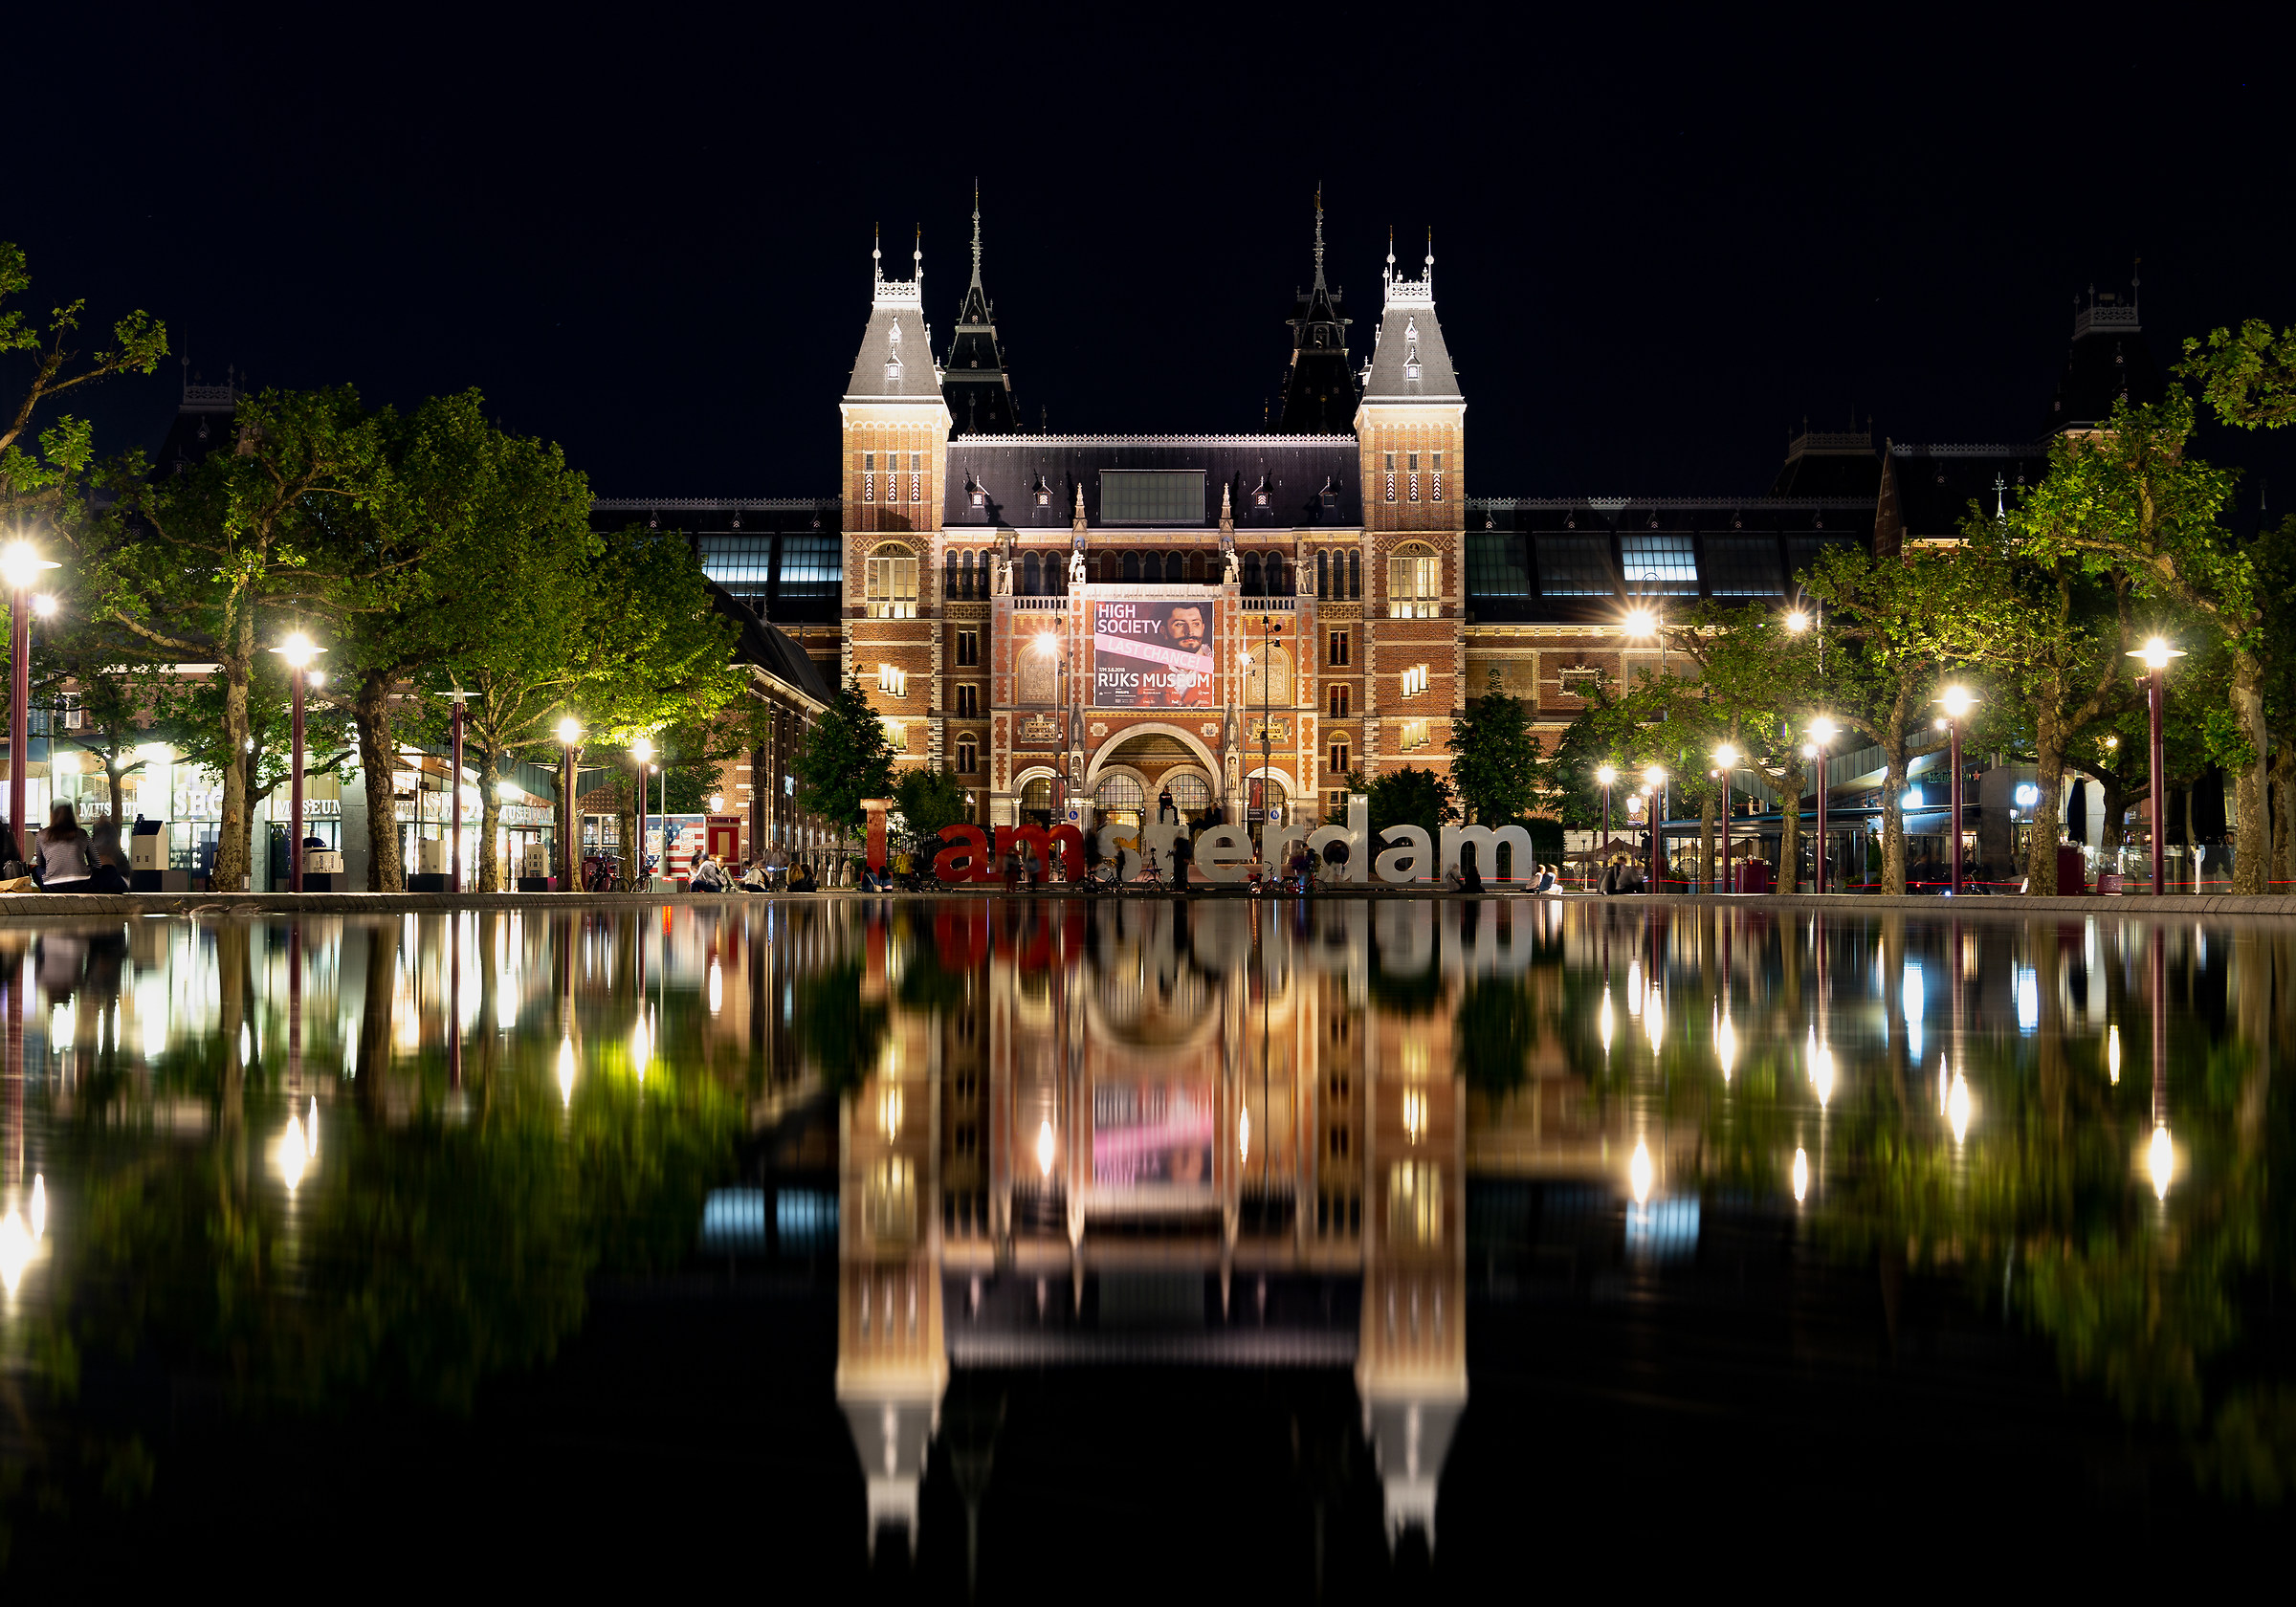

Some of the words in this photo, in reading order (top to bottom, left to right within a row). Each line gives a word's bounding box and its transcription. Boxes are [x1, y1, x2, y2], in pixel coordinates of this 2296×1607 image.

[1098, 605, 1136, 618] HIGH
[1097, 619, 1161, 634] SOCIETY
[1108, 638, 1141, 655] LAST
[1143, 647, 1201, 669] CHANCE!
[1098, 672, 1139, 687] RIJKS
[1142, 673, 1210, 688] MUSEUM
[79, 802, 138, 817] MUSU
[173, 790, 225, 817] SHO
[276, 799, 342, 815] MSEUM
